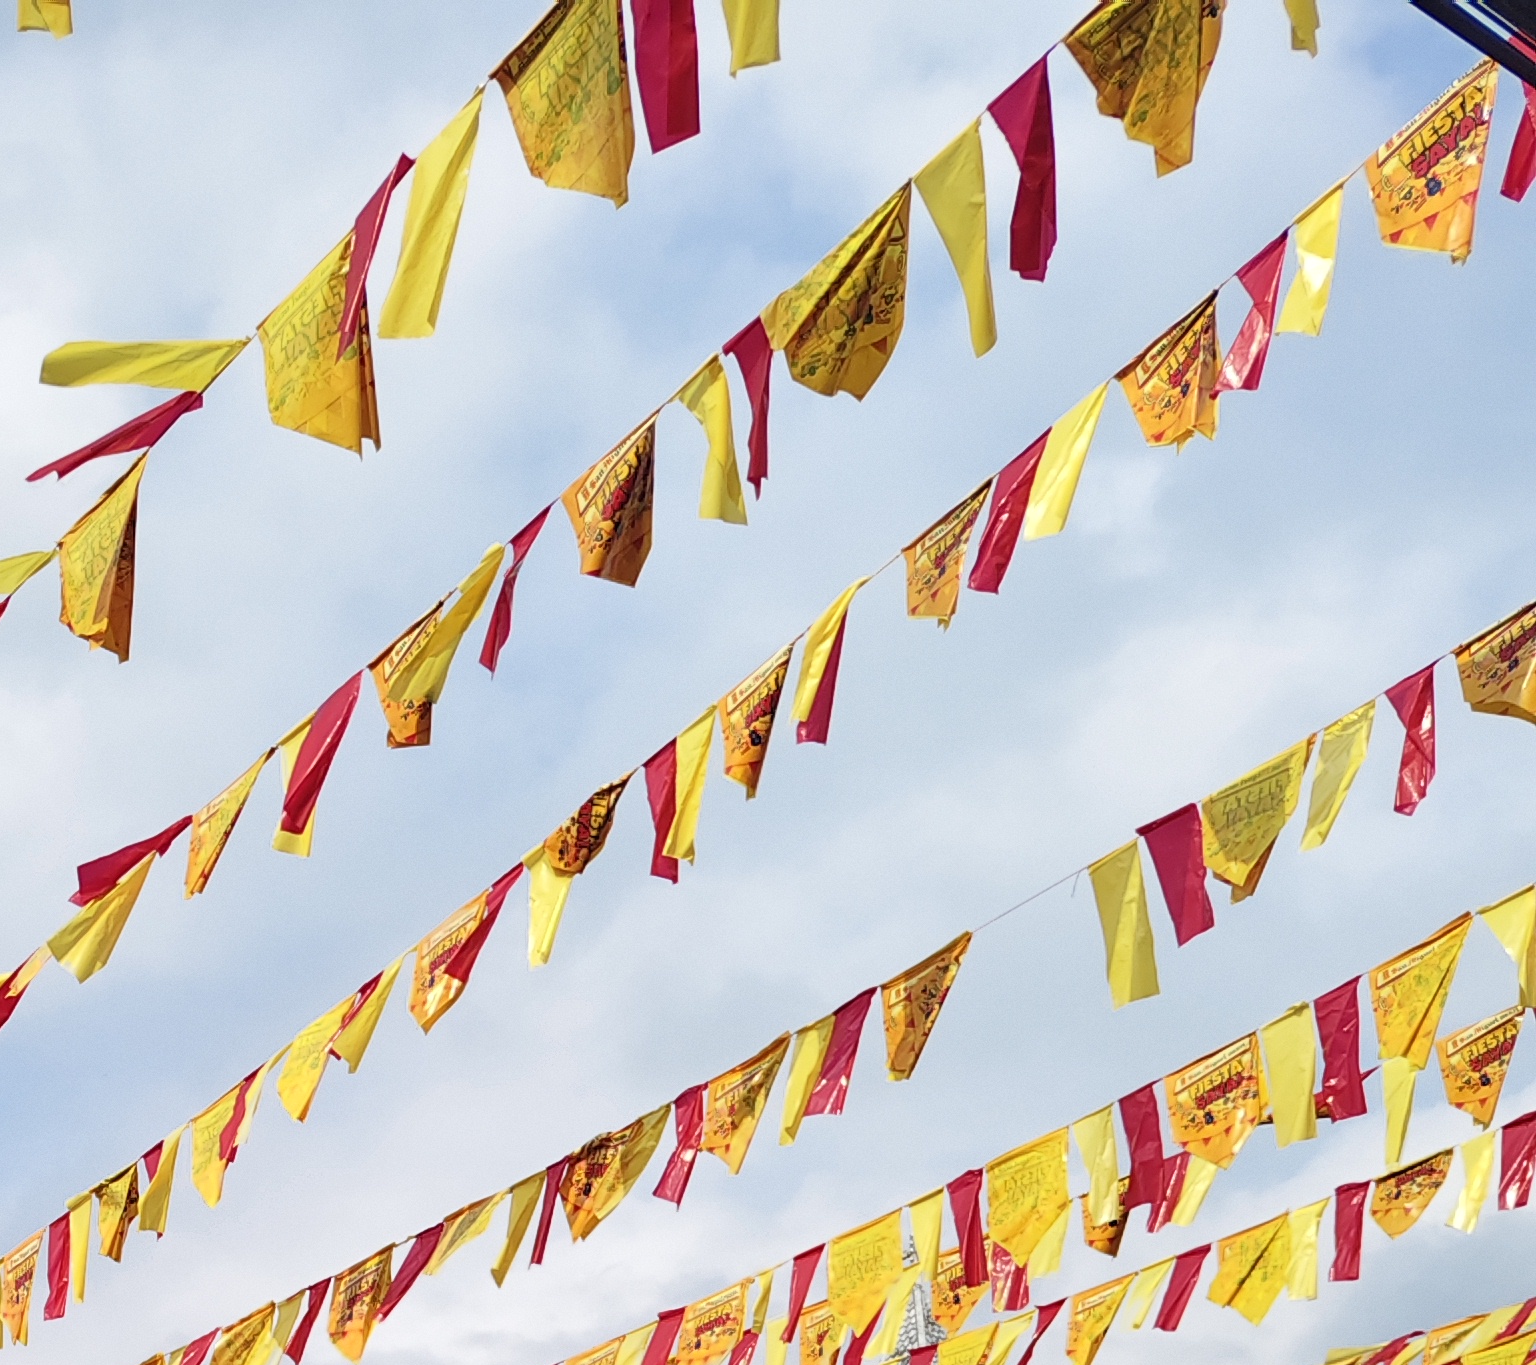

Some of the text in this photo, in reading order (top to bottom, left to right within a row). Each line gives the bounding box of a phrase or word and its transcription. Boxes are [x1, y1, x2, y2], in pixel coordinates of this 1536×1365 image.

[1399, 86, 1484, 167] FIESTA
[1462, 1024, 1517, 1063] FIESTA
[1189, 1058, 1244, 1100] FIESTA
